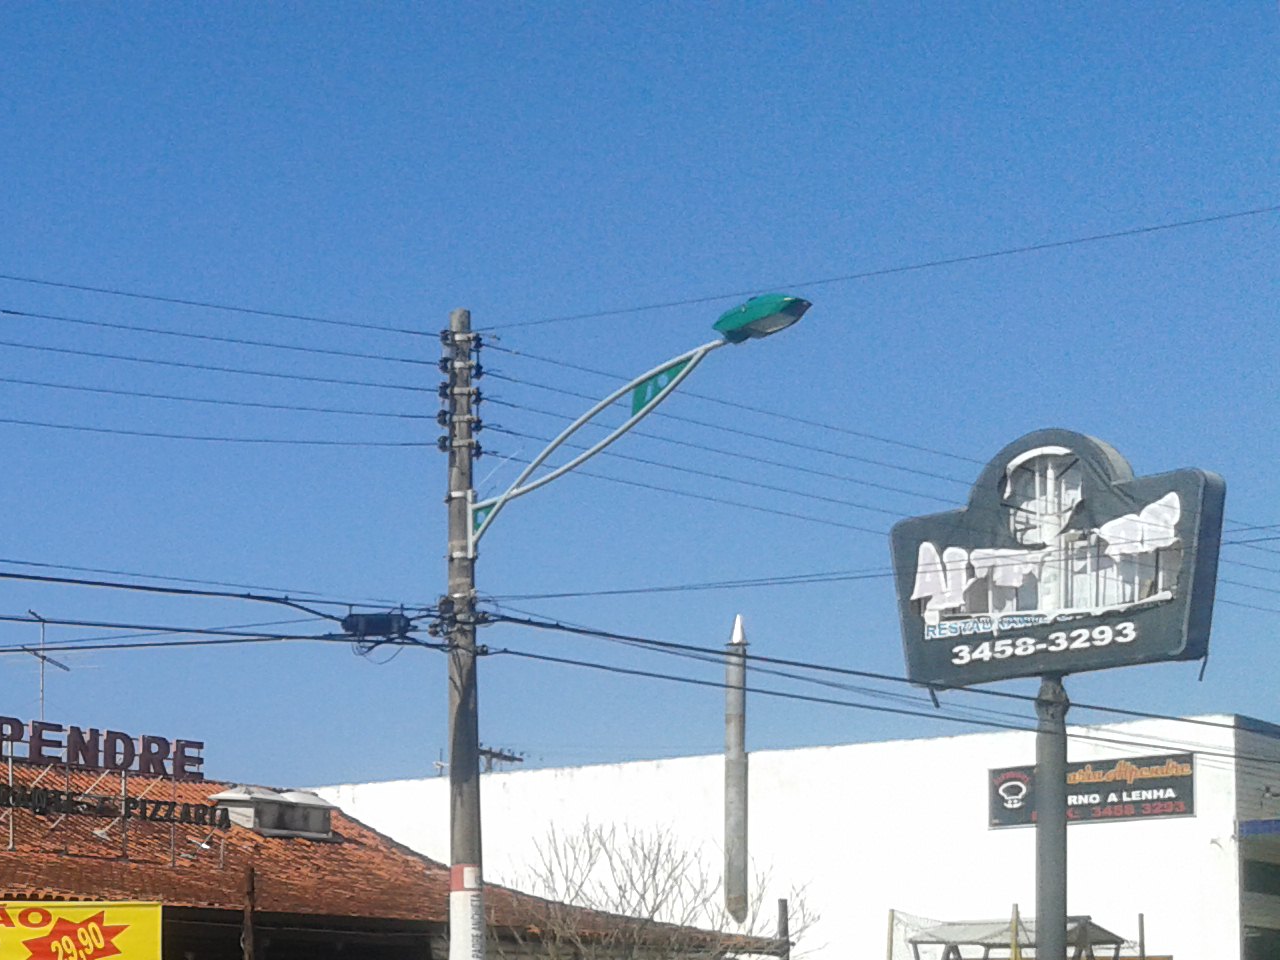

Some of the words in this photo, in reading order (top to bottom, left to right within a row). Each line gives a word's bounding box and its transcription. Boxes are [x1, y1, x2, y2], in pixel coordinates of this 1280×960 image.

[951, 621, 1137, 665] 3458-3293
[1067, 793, 1100, 806] RNO
[1107, 791, 1119, 803] A
[1122, 787, 1177, 802] LENHA
